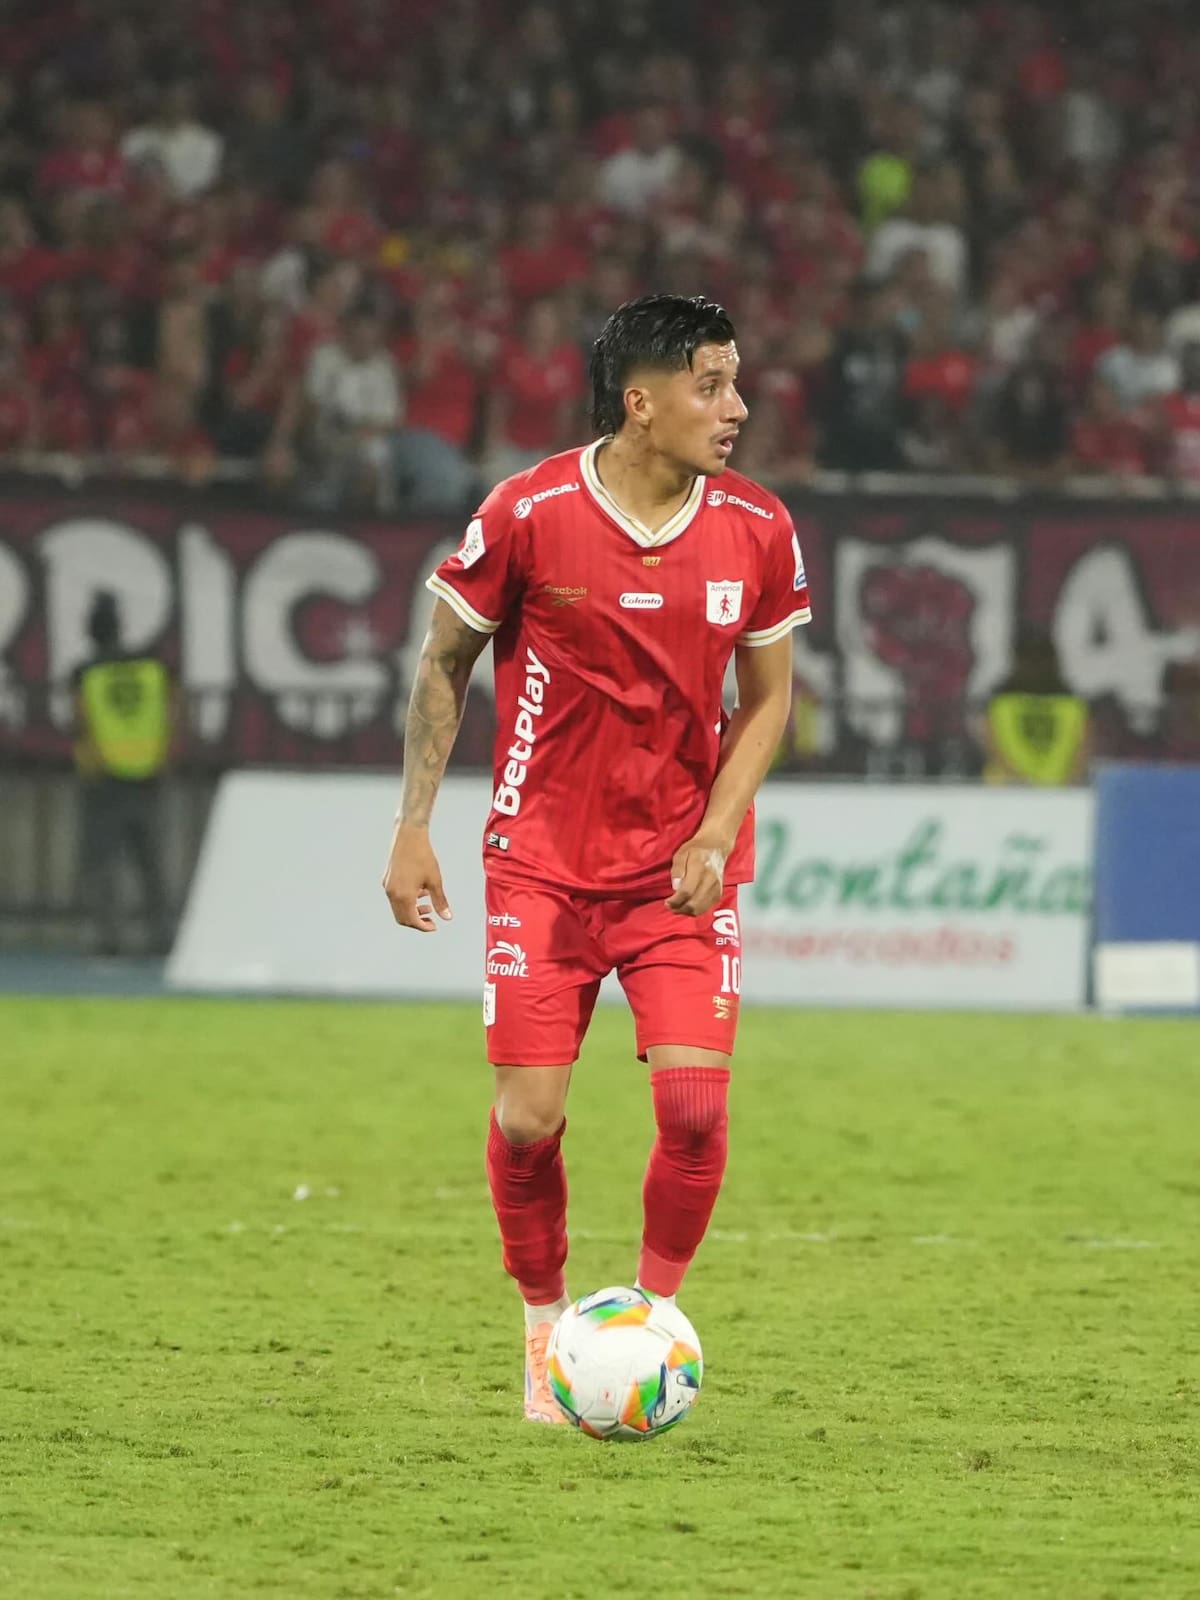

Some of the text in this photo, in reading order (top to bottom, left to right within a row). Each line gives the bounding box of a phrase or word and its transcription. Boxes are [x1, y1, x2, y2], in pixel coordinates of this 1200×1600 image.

[532, 482, 580, 503] EMCALI
[727, 495, 774, 520] EMCALI
[621, 595, 662, 605] Colanta
[493, 646, 550, 817] BetPlay
[720, 953, 740, 995] 10
